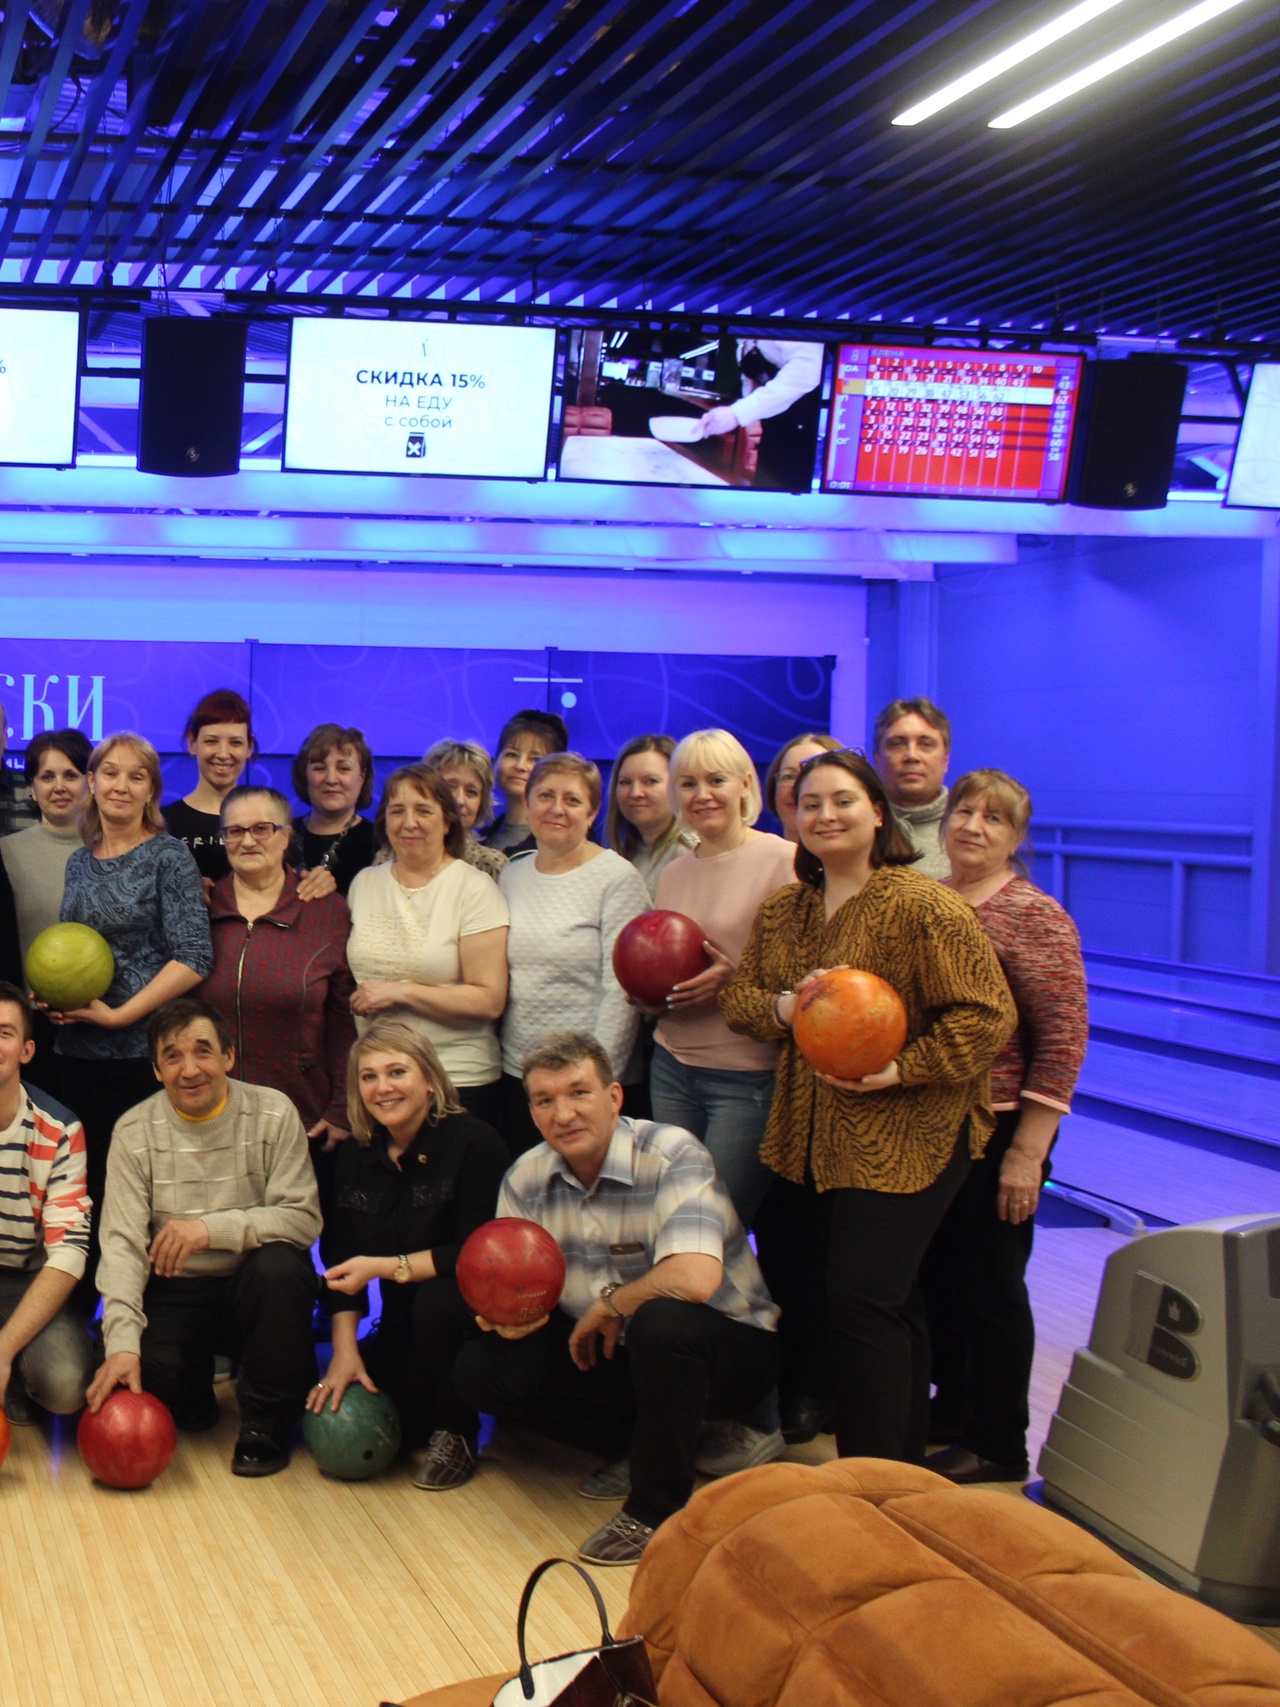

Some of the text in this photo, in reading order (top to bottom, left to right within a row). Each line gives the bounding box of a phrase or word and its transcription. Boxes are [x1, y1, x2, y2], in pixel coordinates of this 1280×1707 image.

[875, 357, 1043, 374] 1 2 3 4 5 6 7 8 9 10
[356, 369, 485, 389] СКИДКА 15%
[385, 395, 453, 410] НА ЕДУ
[870, 401, 877, 410] 7
[886, 402, 897, 411] 12
[384, 414, 452, 429] с собой
[868, 416, 875, 425] 3
[884, 416, 895, 425] 12
[901, 417, 913, 426] 20
[867, 430, 874, 439] 7
[864, 444, 872, 453] 0
